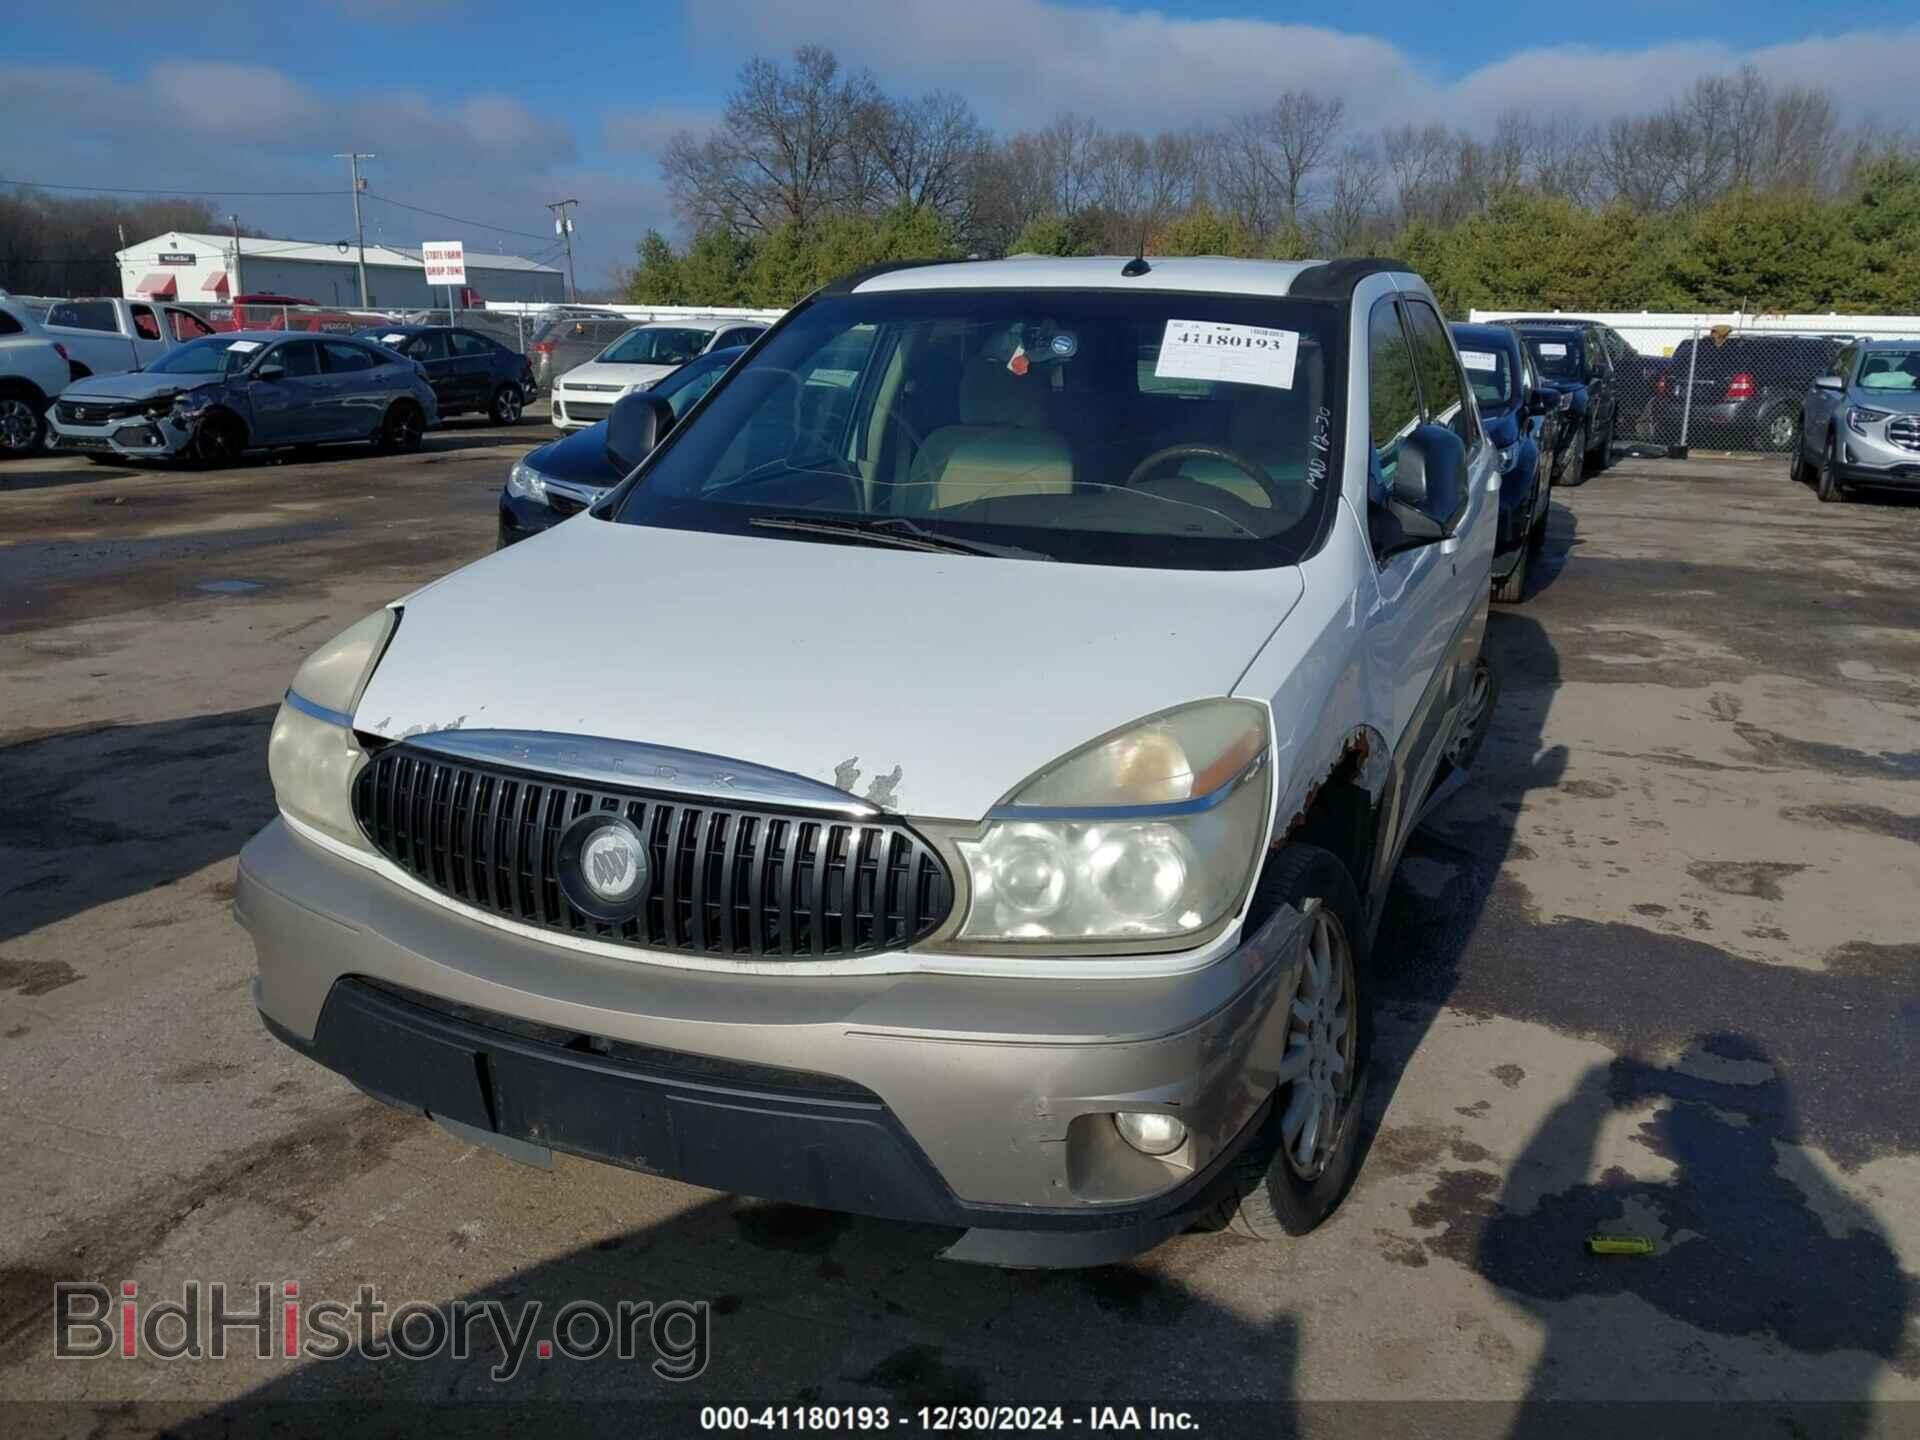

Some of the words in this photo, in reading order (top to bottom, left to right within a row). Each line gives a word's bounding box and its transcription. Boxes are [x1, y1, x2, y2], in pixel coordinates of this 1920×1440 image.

[425, 249, 443, 260] STATE
[444, 249, 462, 260] FARM
[427, 266, 445, 275] DROP
[1178, 332, 1281, 351] 41180193
[1309, 406, 1331, 452] 12-30
